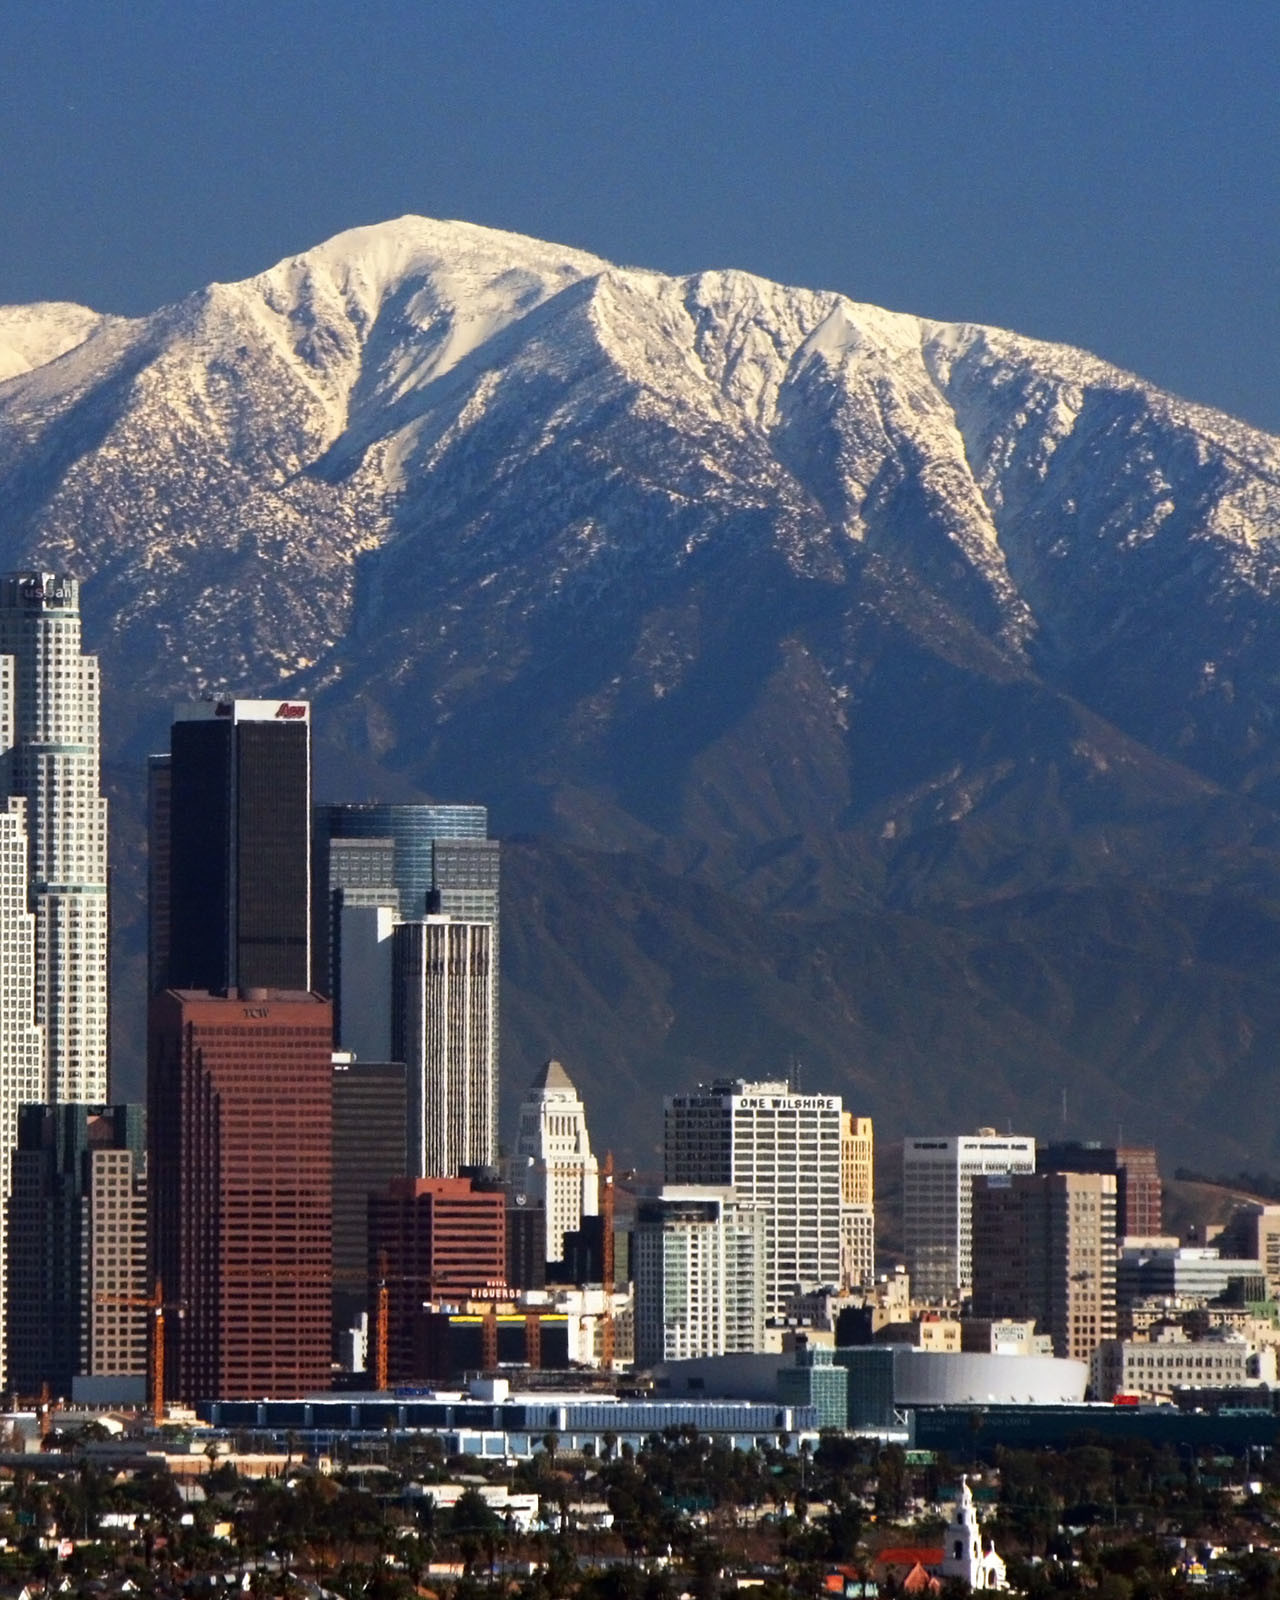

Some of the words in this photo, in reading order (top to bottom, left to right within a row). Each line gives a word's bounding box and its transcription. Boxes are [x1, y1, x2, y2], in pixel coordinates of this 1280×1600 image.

[242, 1007, 269, 1018] TCW
[740, 1098, 766, 1109] ONE
[771, 1099, 834, 1109] WILSHIRE
[471, 1289, 521, 1298] FIGUEROA
